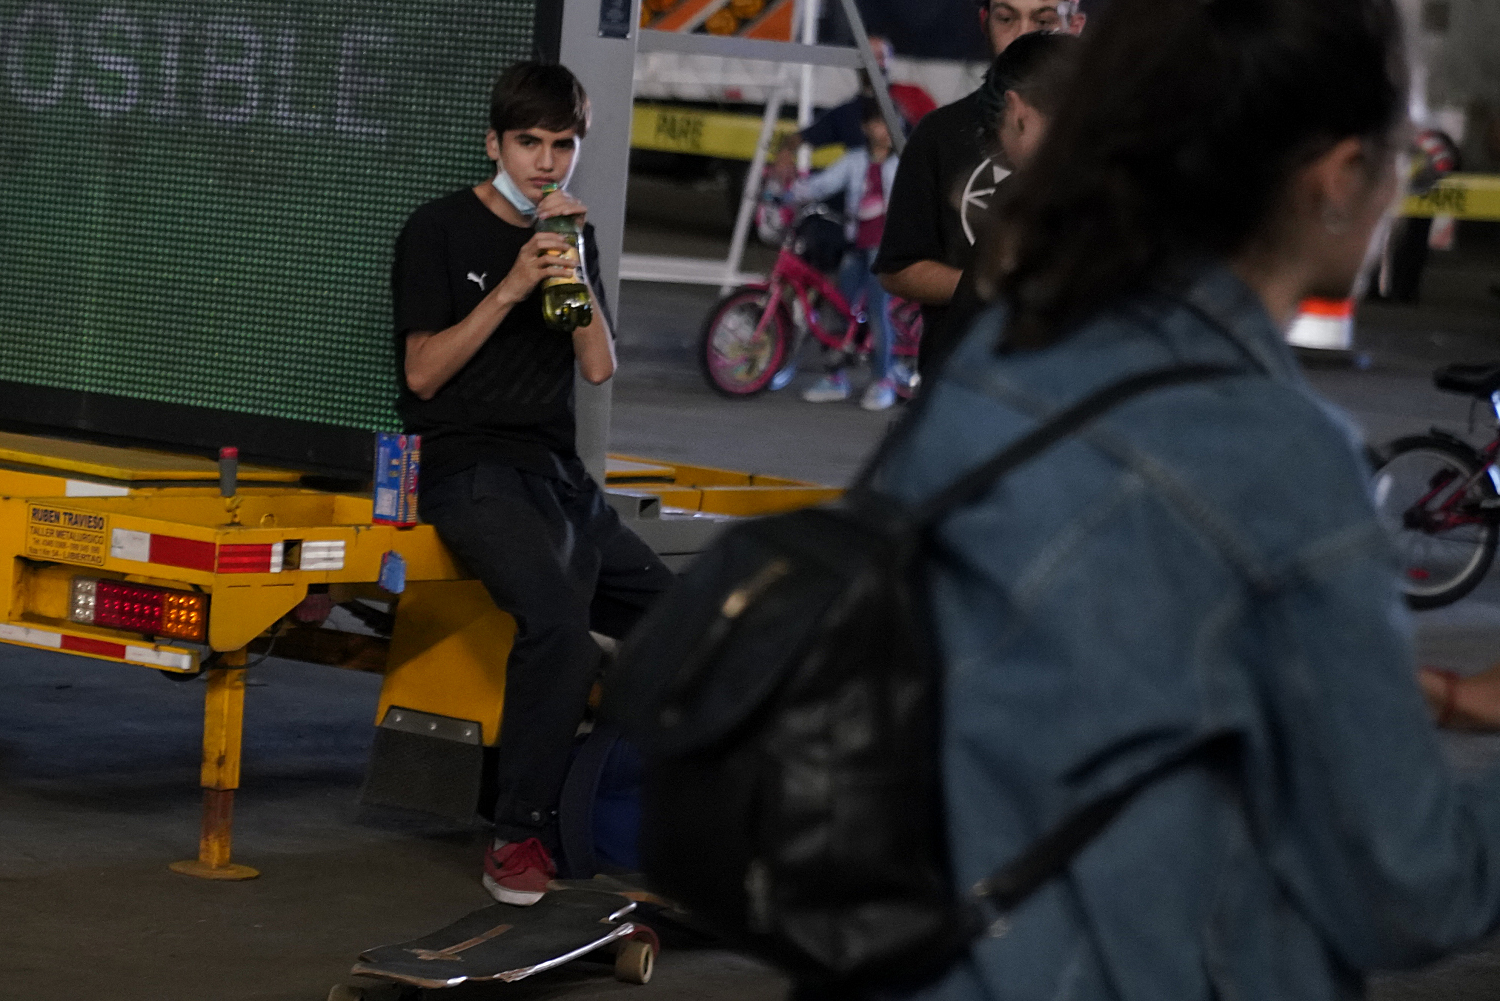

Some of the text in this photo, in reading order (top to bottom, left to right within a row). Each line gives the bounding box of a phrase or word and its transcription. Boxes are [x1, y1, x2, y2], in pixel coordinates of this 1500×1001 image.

[31, 507, 104, 529] RUBEN TRAVIESO
[30, 525, 54, 537] TALLER
